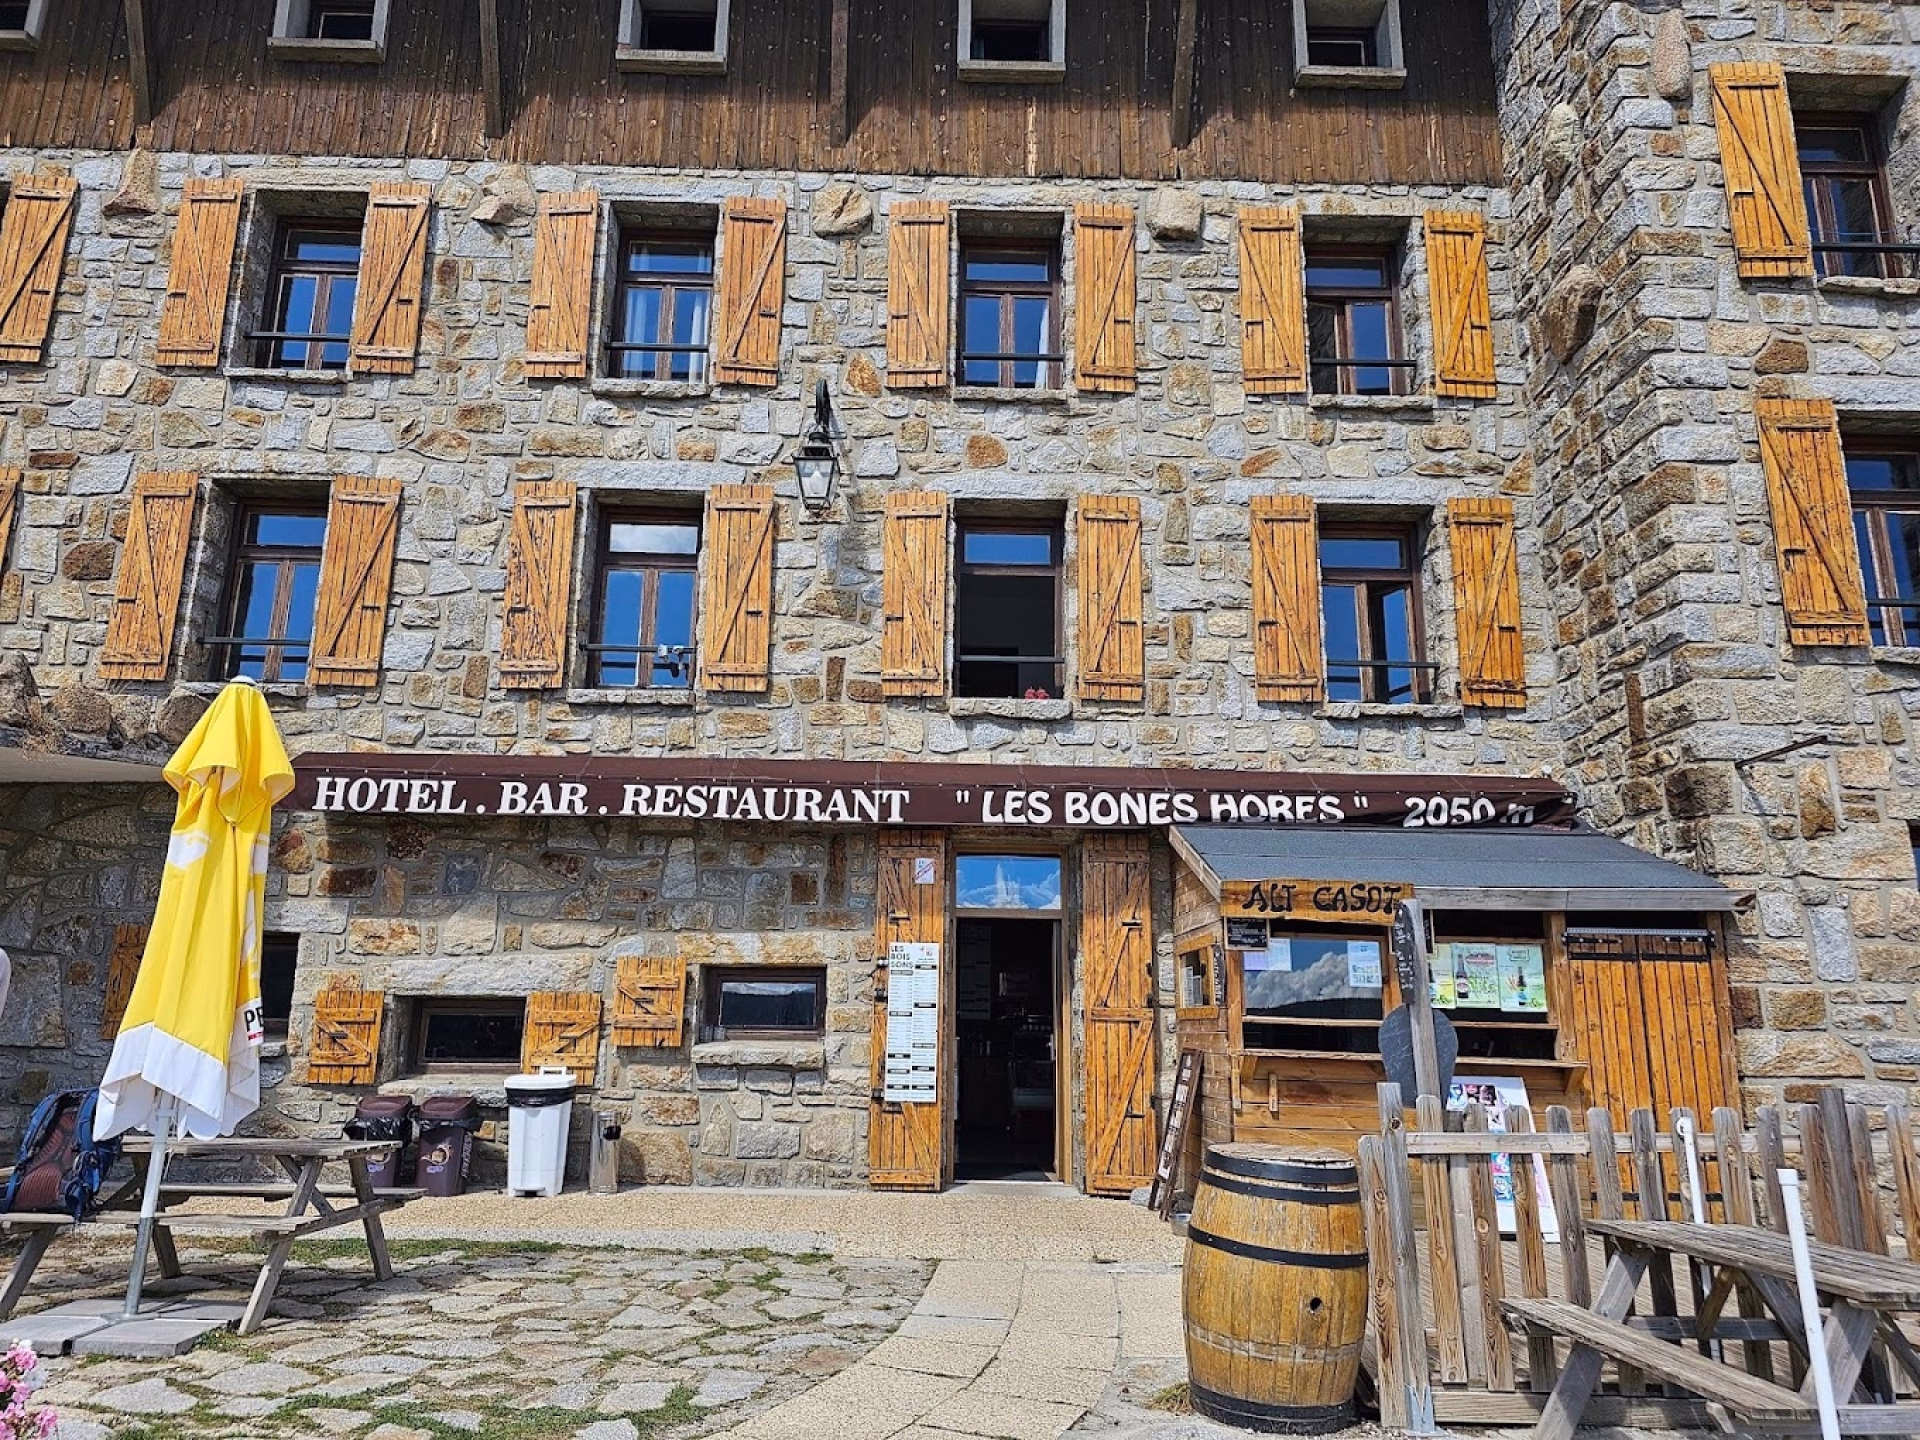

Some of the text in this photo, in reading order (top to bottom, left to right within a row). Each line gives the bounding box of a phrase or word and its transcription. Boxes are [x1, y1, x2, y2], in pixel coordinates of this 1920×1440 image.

[312, 777, 467, 812] HOTEL
[497, 781, 589, 814] BAR
[619, 784, 910, 822] RESTAURANT
[982, 791, 1053, 823] LES
[1065, 792, 1199, 825] BONES
[1210, 793, 1345, 823] HORES
[1403, 796, 1496, 828] 2050
[1242, 883, 1402, 914] ALT CASOT
